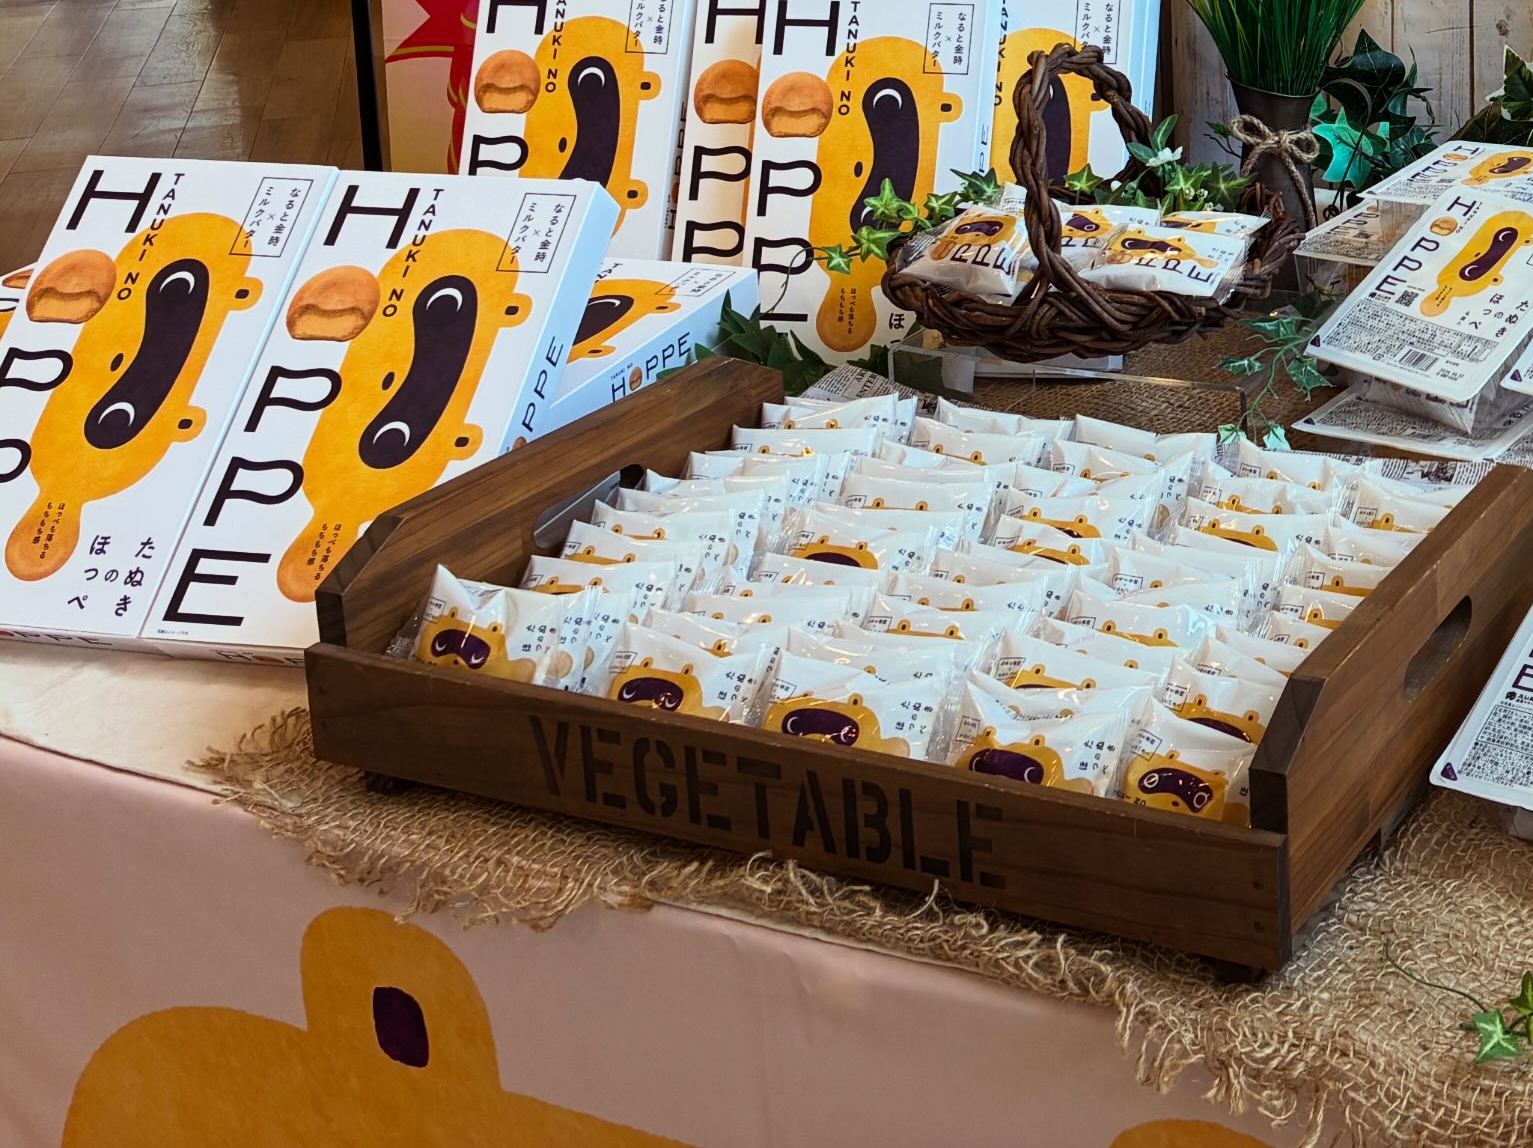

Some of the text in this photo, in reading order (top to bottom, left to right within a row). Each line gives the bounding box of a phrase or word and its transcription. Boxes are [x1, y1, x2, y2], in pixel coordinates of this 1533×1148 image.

[844, 1, 862, 83] TANUKI
[931, 11, 945, 69] ミルクバター
[951, 11, 968, 66] なると金時
[134, 173, 185, 263] TANUKI
[241, 186, 275, 250] ミルクバター
[267, 187, 302, 247] なると金時
[402, 188, 445, 279] TANUKI
[509, 202, 538, 266] ミルクバター
[533, 203, 564, 263] なると金時
[104, 568, 117, 582] の
[114, 536, 154, 617] たぬき
[527, 714, 1006, 890] VEGETABLE
